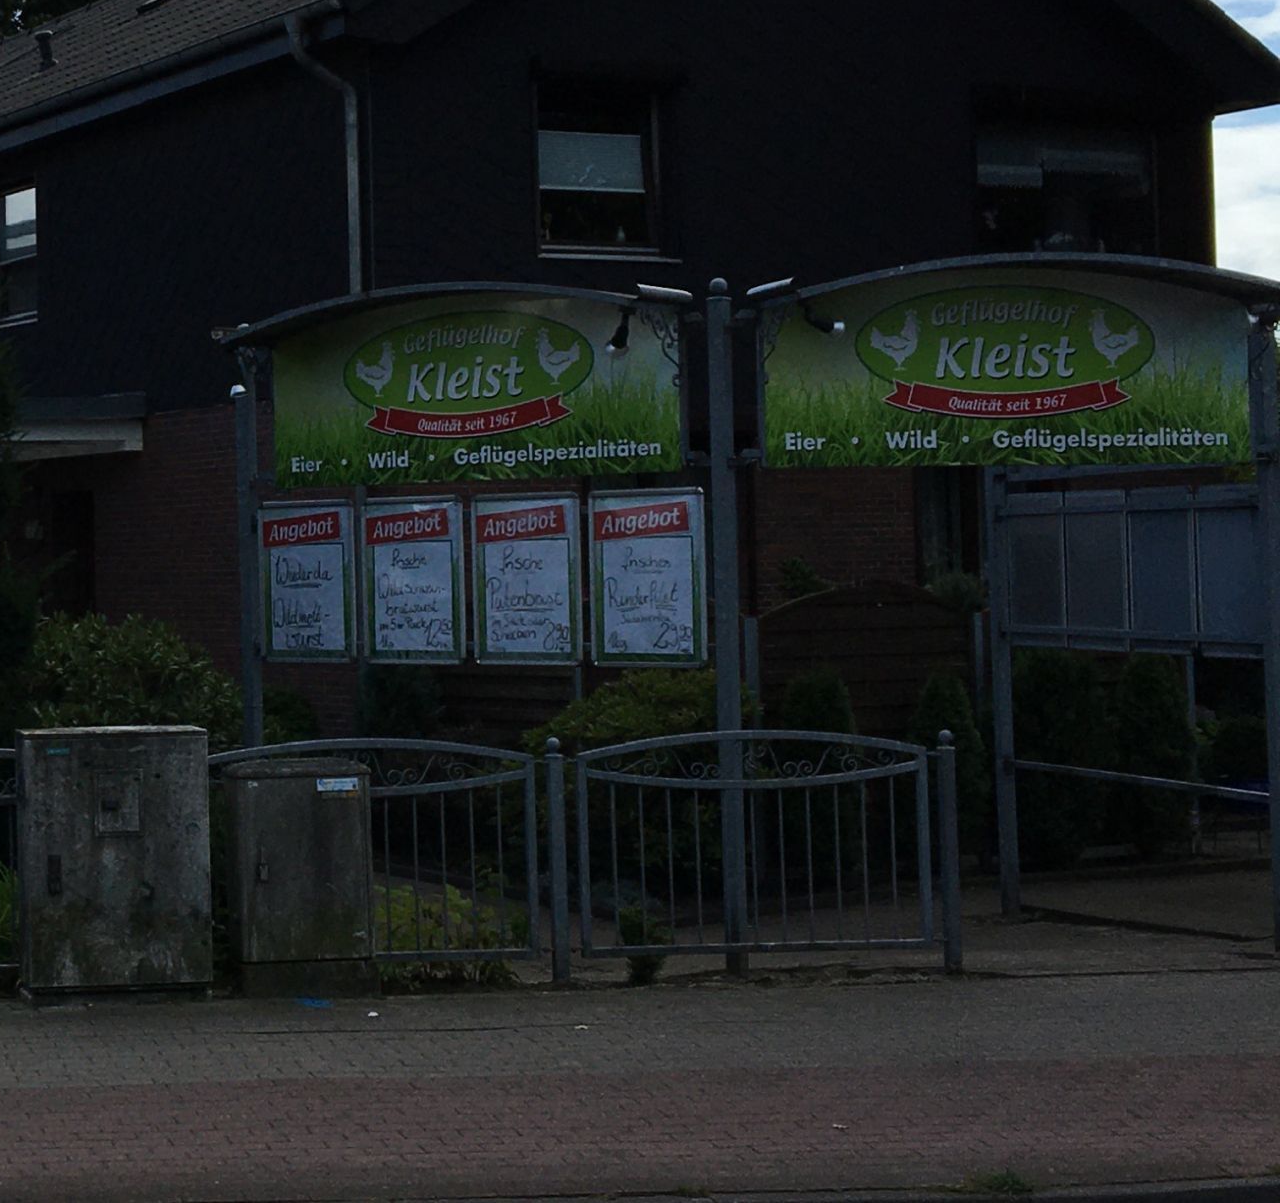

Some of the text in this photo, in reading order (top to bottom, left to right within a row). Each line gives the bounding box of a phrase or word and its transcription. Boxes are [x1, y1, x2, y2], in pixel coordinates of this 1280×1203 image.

[931, 300, 1079, 329] Geflügelhof
[403, 323, 526, 355] Geflügelhof
[934, 335, 1078, 379] Kleist
[406, 355, 524, 403] Kleist
[947, 394, 1068, 413] Qualität seit 1967
[417, 411, 518, 433] Qualität seit 1967
[784, 428, 1229, 452] Eier Wild Geflügelspezialitäten
[291, 440, 662, 473] Eier Wild Geflügelspezialitäten
[269, 516, 334, 543] Angebot
[373, 513, 442, 539] Angebot
[483, 509, 558, 537] Angebot
[601, 507, 681, 535] Angebot
